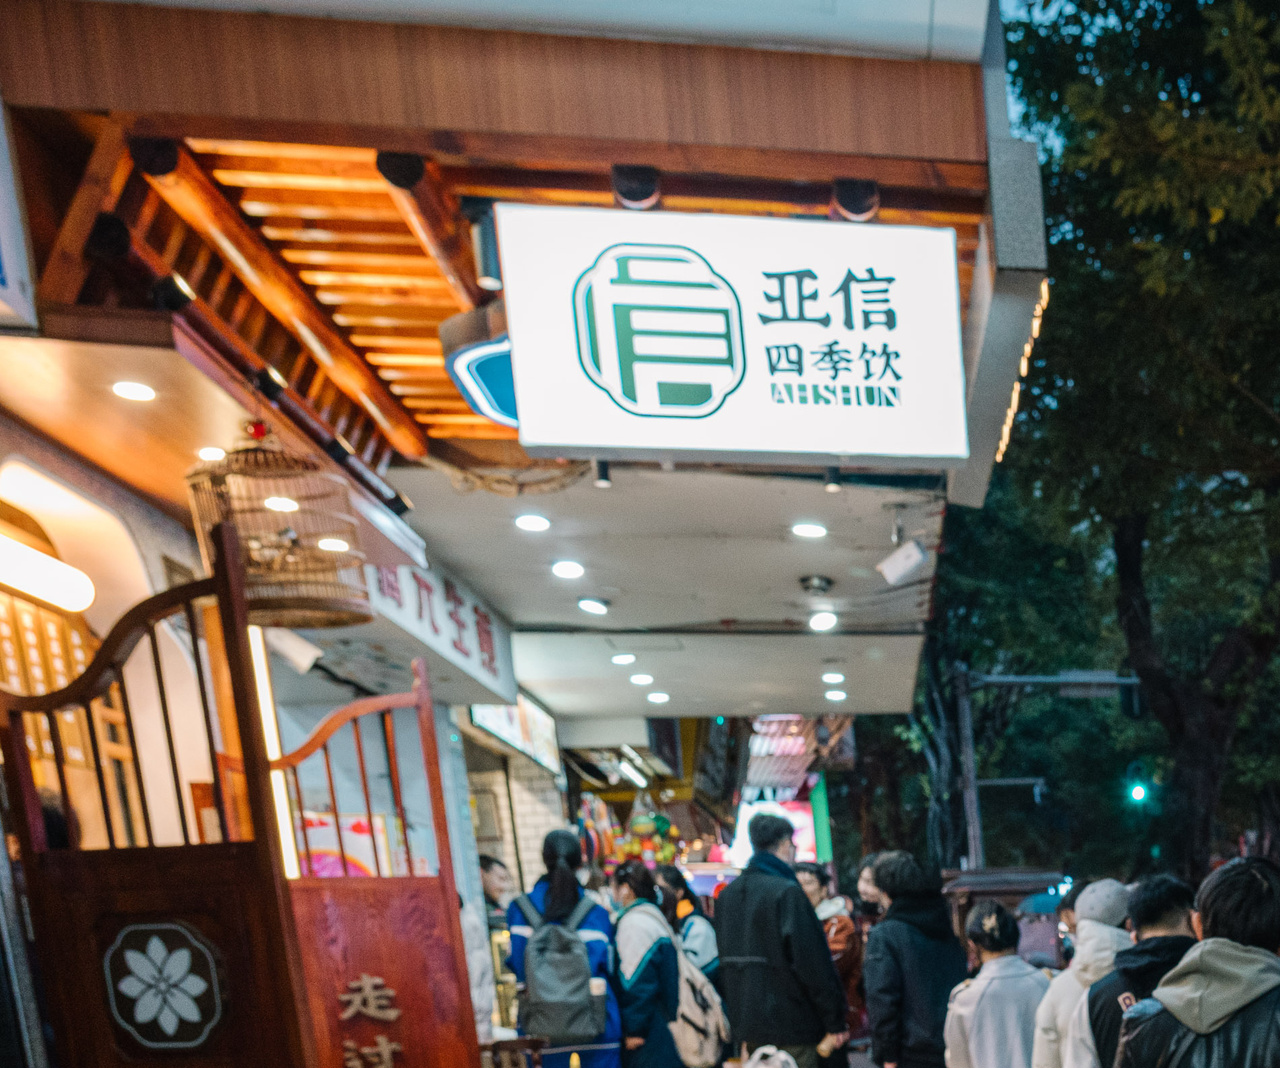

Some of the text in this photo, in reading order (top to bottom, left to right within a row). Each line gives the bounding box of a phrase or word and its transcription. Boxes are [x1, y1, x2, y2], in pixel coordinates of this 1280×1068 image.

[757, 267, 897, 332] 亚信
[765, 340, 903, 381] 四季饮
